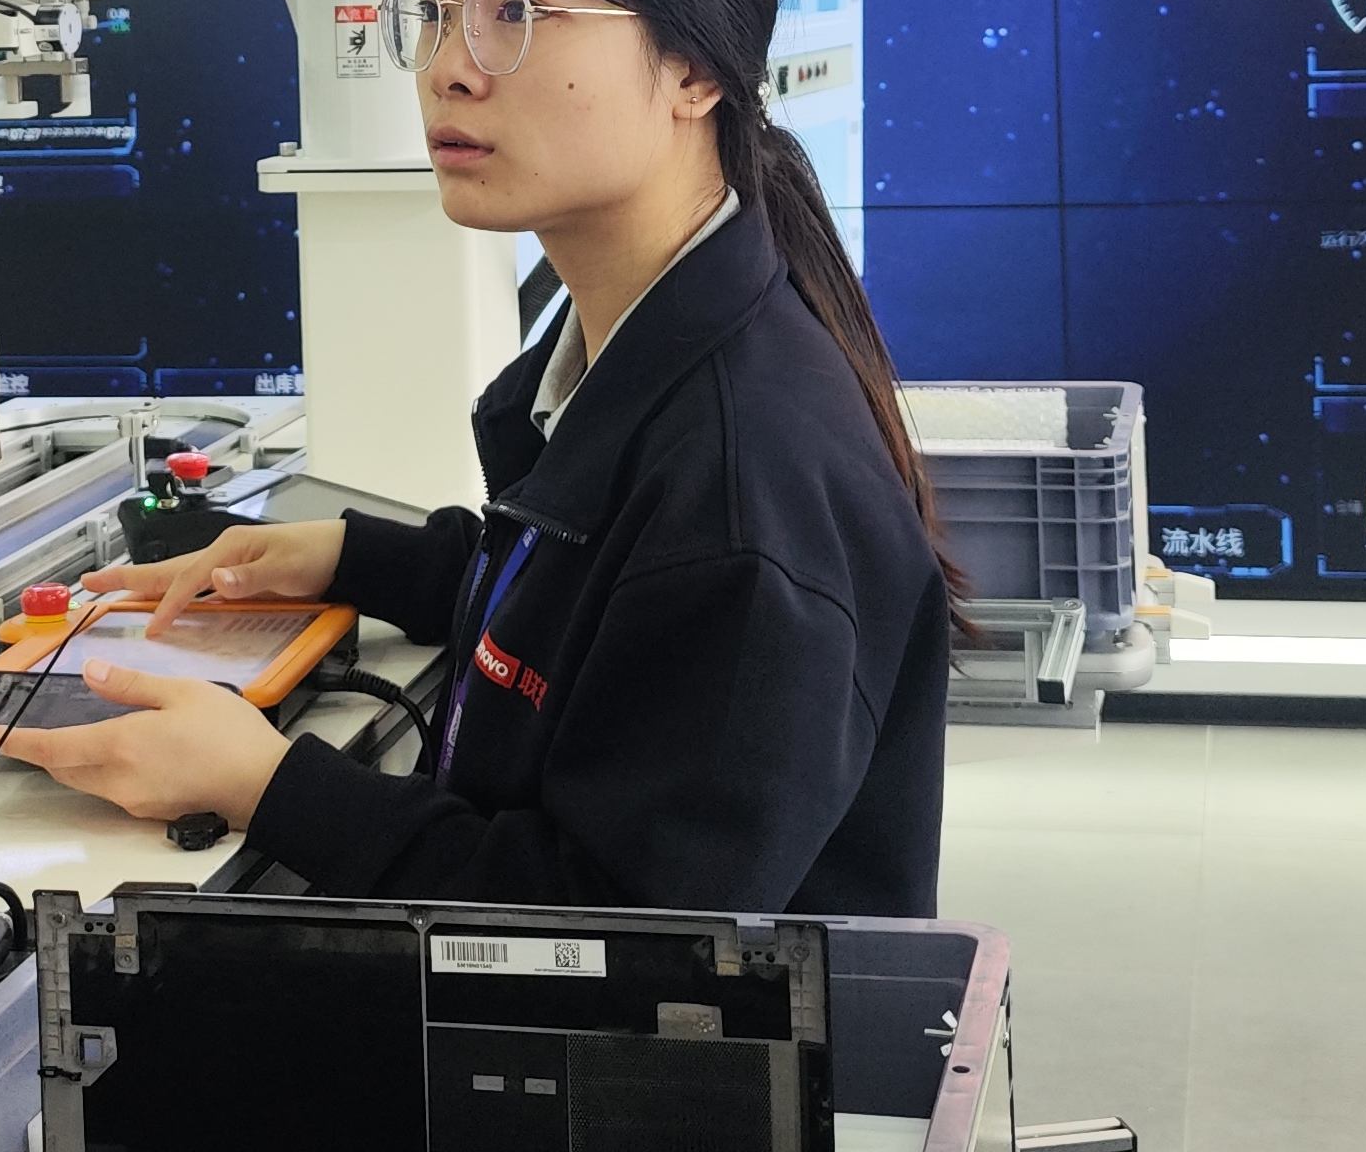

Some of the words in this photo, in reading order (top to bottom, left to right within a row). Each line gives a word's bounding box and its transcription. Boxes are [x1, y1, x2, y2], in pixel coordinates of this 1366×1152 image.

[1162, 527, 1245, 557] 流水线
[475, 639, 509, 677] novo
